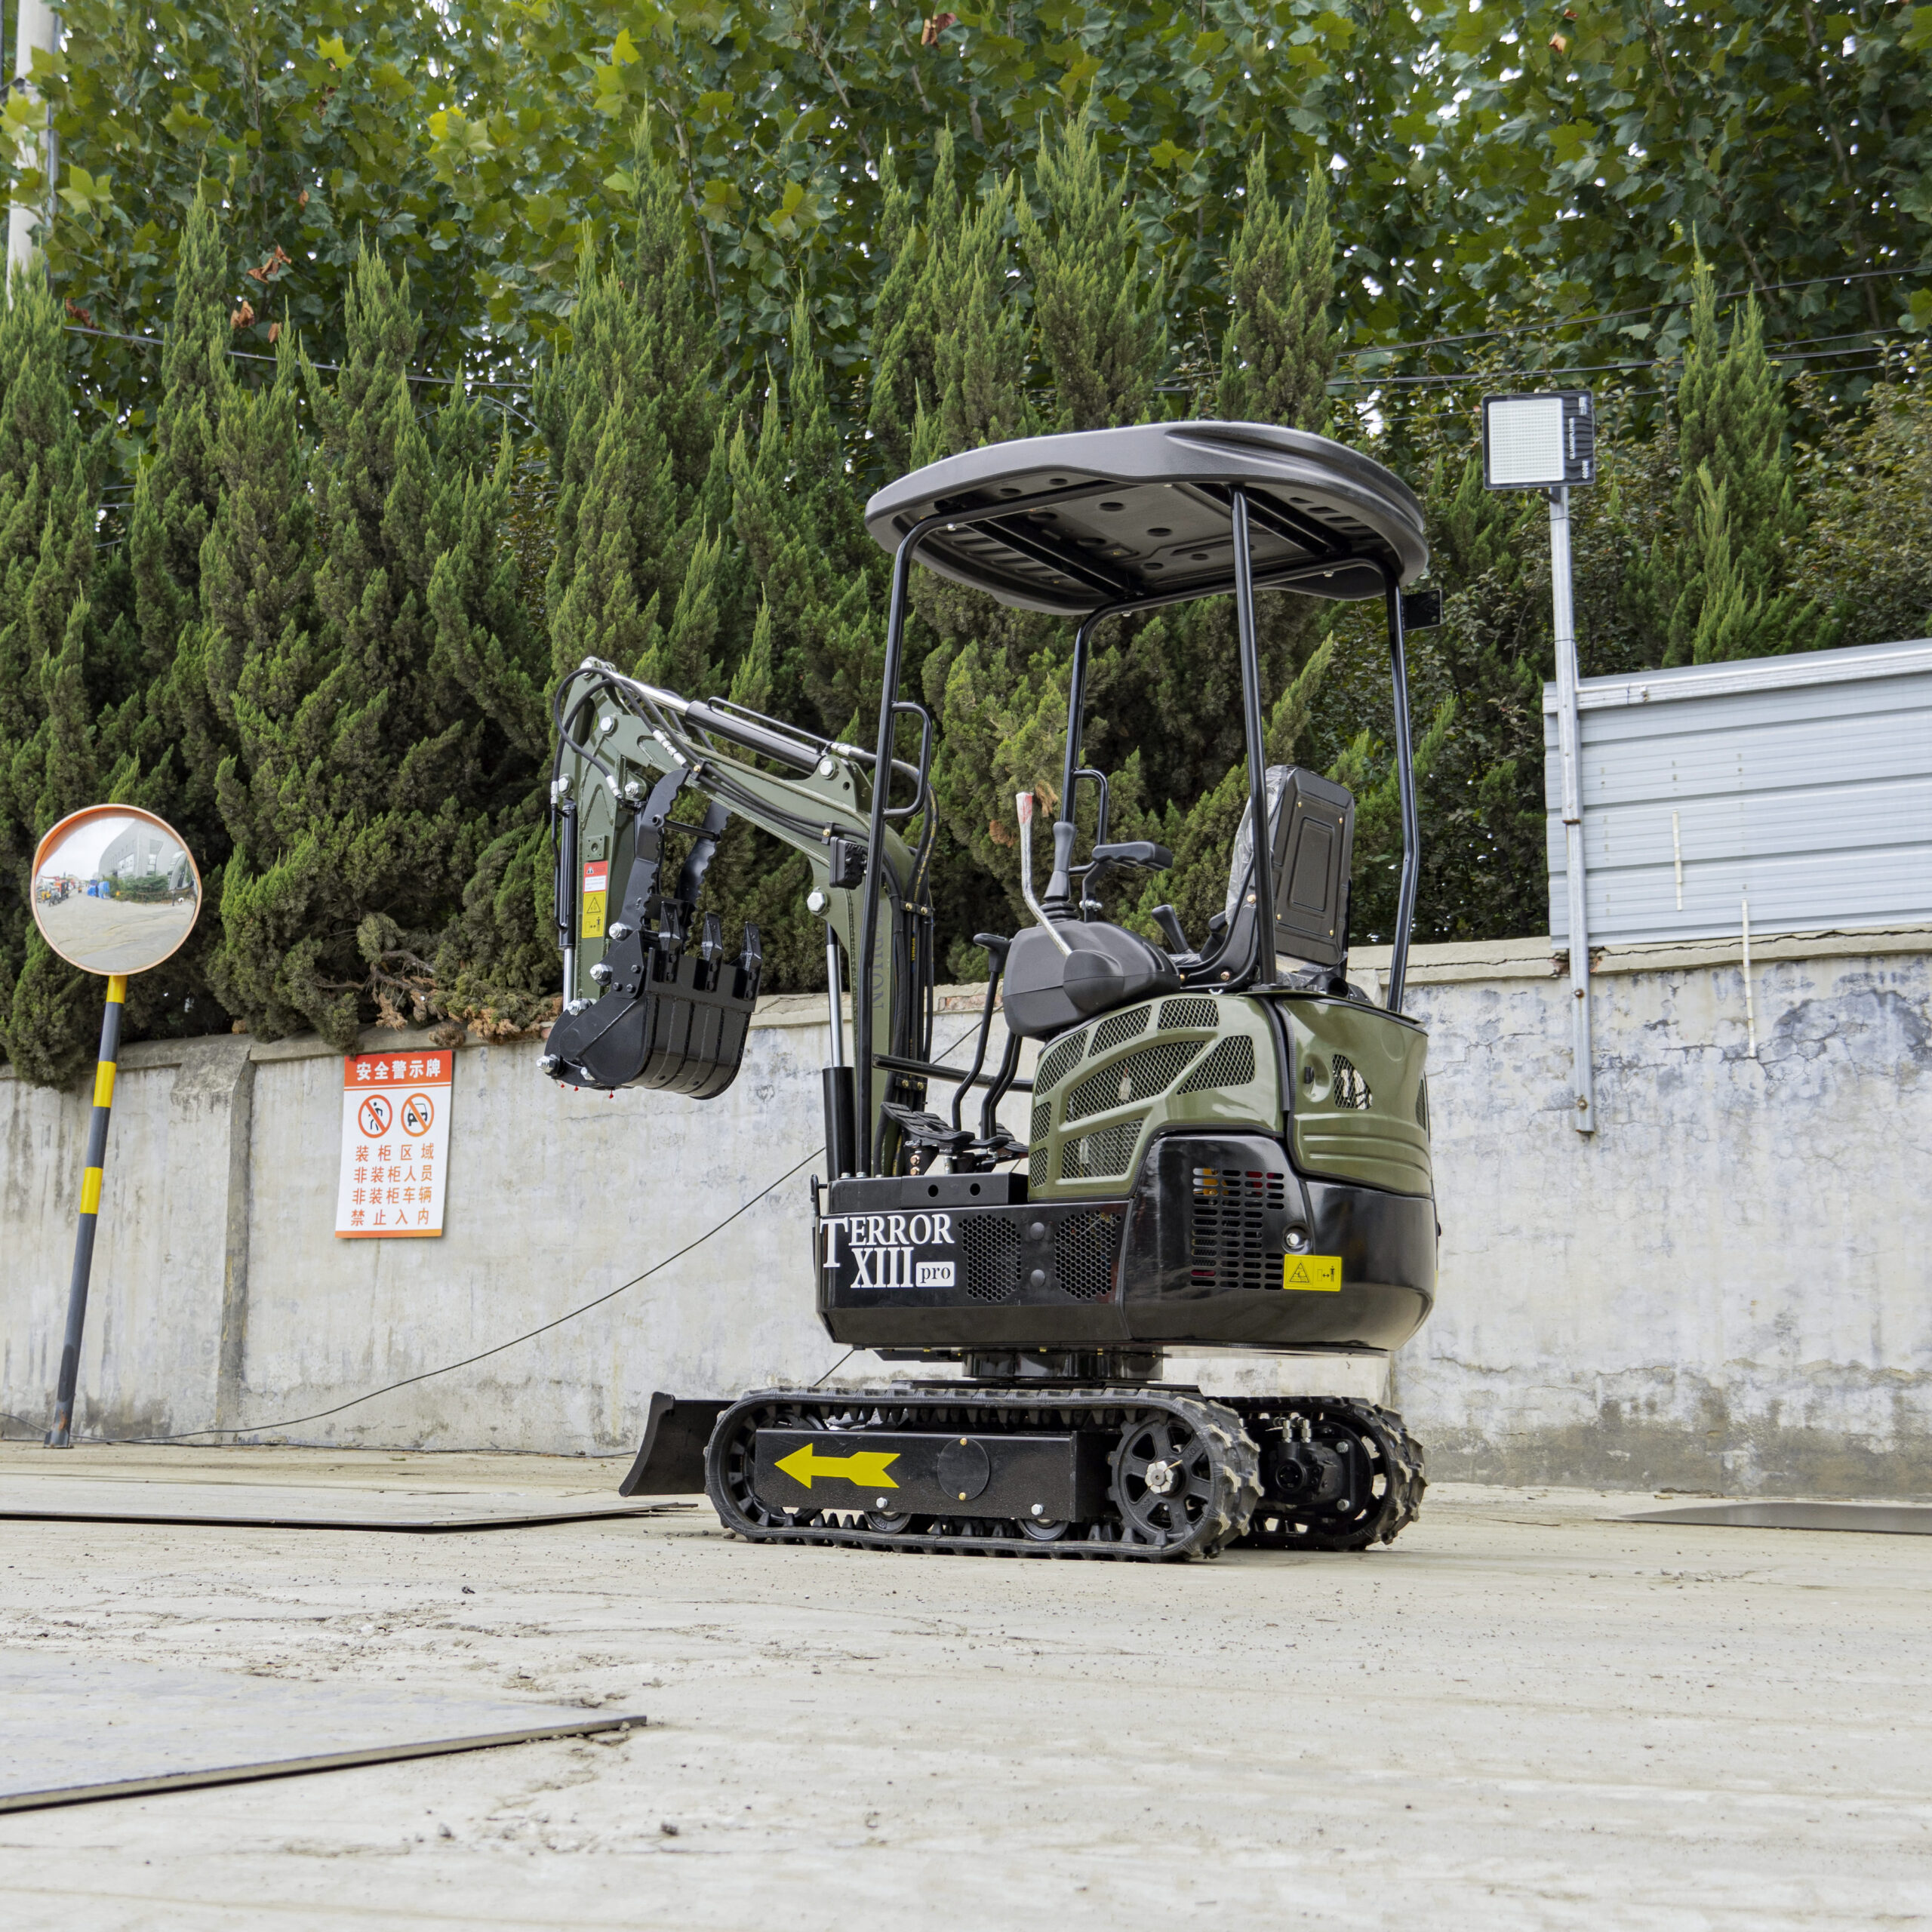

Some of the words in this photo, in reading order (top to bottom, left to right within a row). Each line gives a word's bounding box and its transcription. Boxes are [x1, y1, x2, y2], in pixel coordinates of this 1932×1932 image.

[356, 1058, 441, 1081] 安全警示牌
[355, 1143, 435, 1162] 装柜区域
[353, 1164, 433, 1183] 非装柜人员
[352, 1186, 432, 1205] 非装柜车辆
[350, 1208, 429, 1227] 禁止入内
[820, 1214, 955, 1268] TERROR
[850, 1247, 915, 1288] XIII
[920, 1266, 951, 1283] pro
